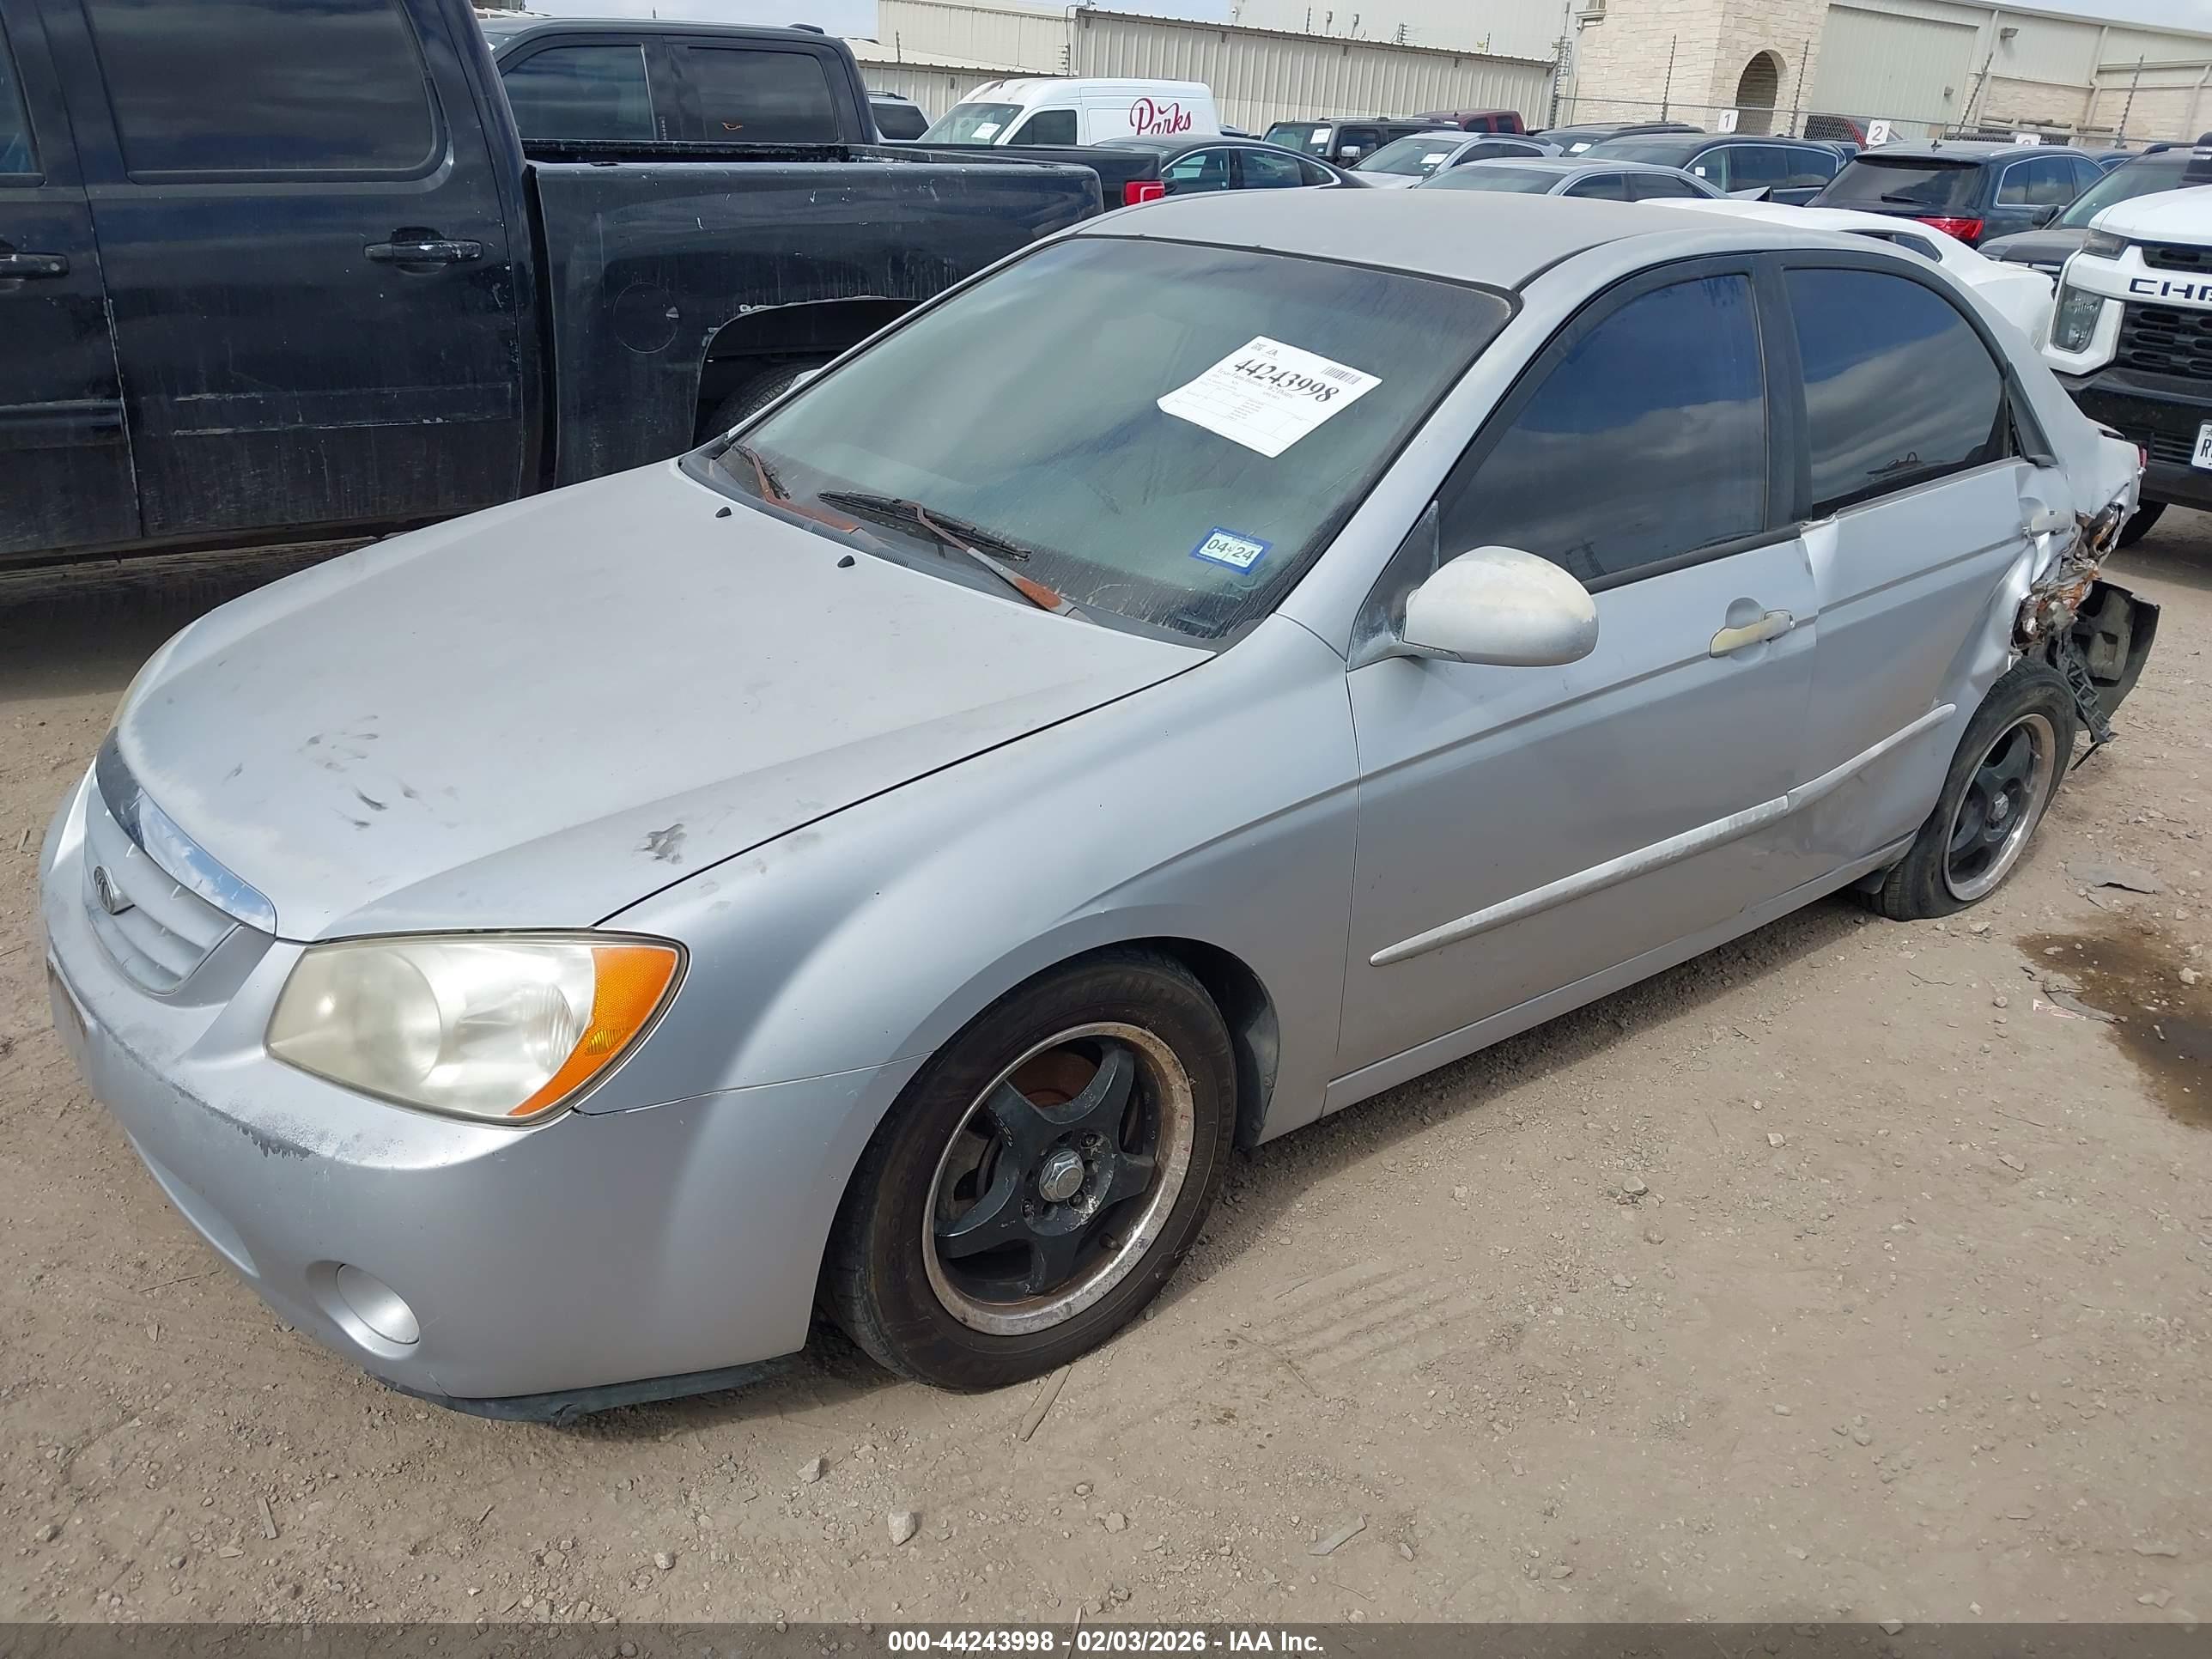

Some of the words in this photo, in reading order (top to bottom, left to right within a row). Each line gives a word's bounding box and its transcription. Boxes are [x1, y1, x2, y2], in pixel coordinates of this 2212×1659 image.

[1129, 97, 1191, 136] Parks
[1724, 113, 1731, 129] 1
[1872, 125, 1883, 141] 2
[1234, 358, 1340, 403] 44243998
[1206, 538, 1227, 553] 04
[1232, 546, 1255, 561] 24
